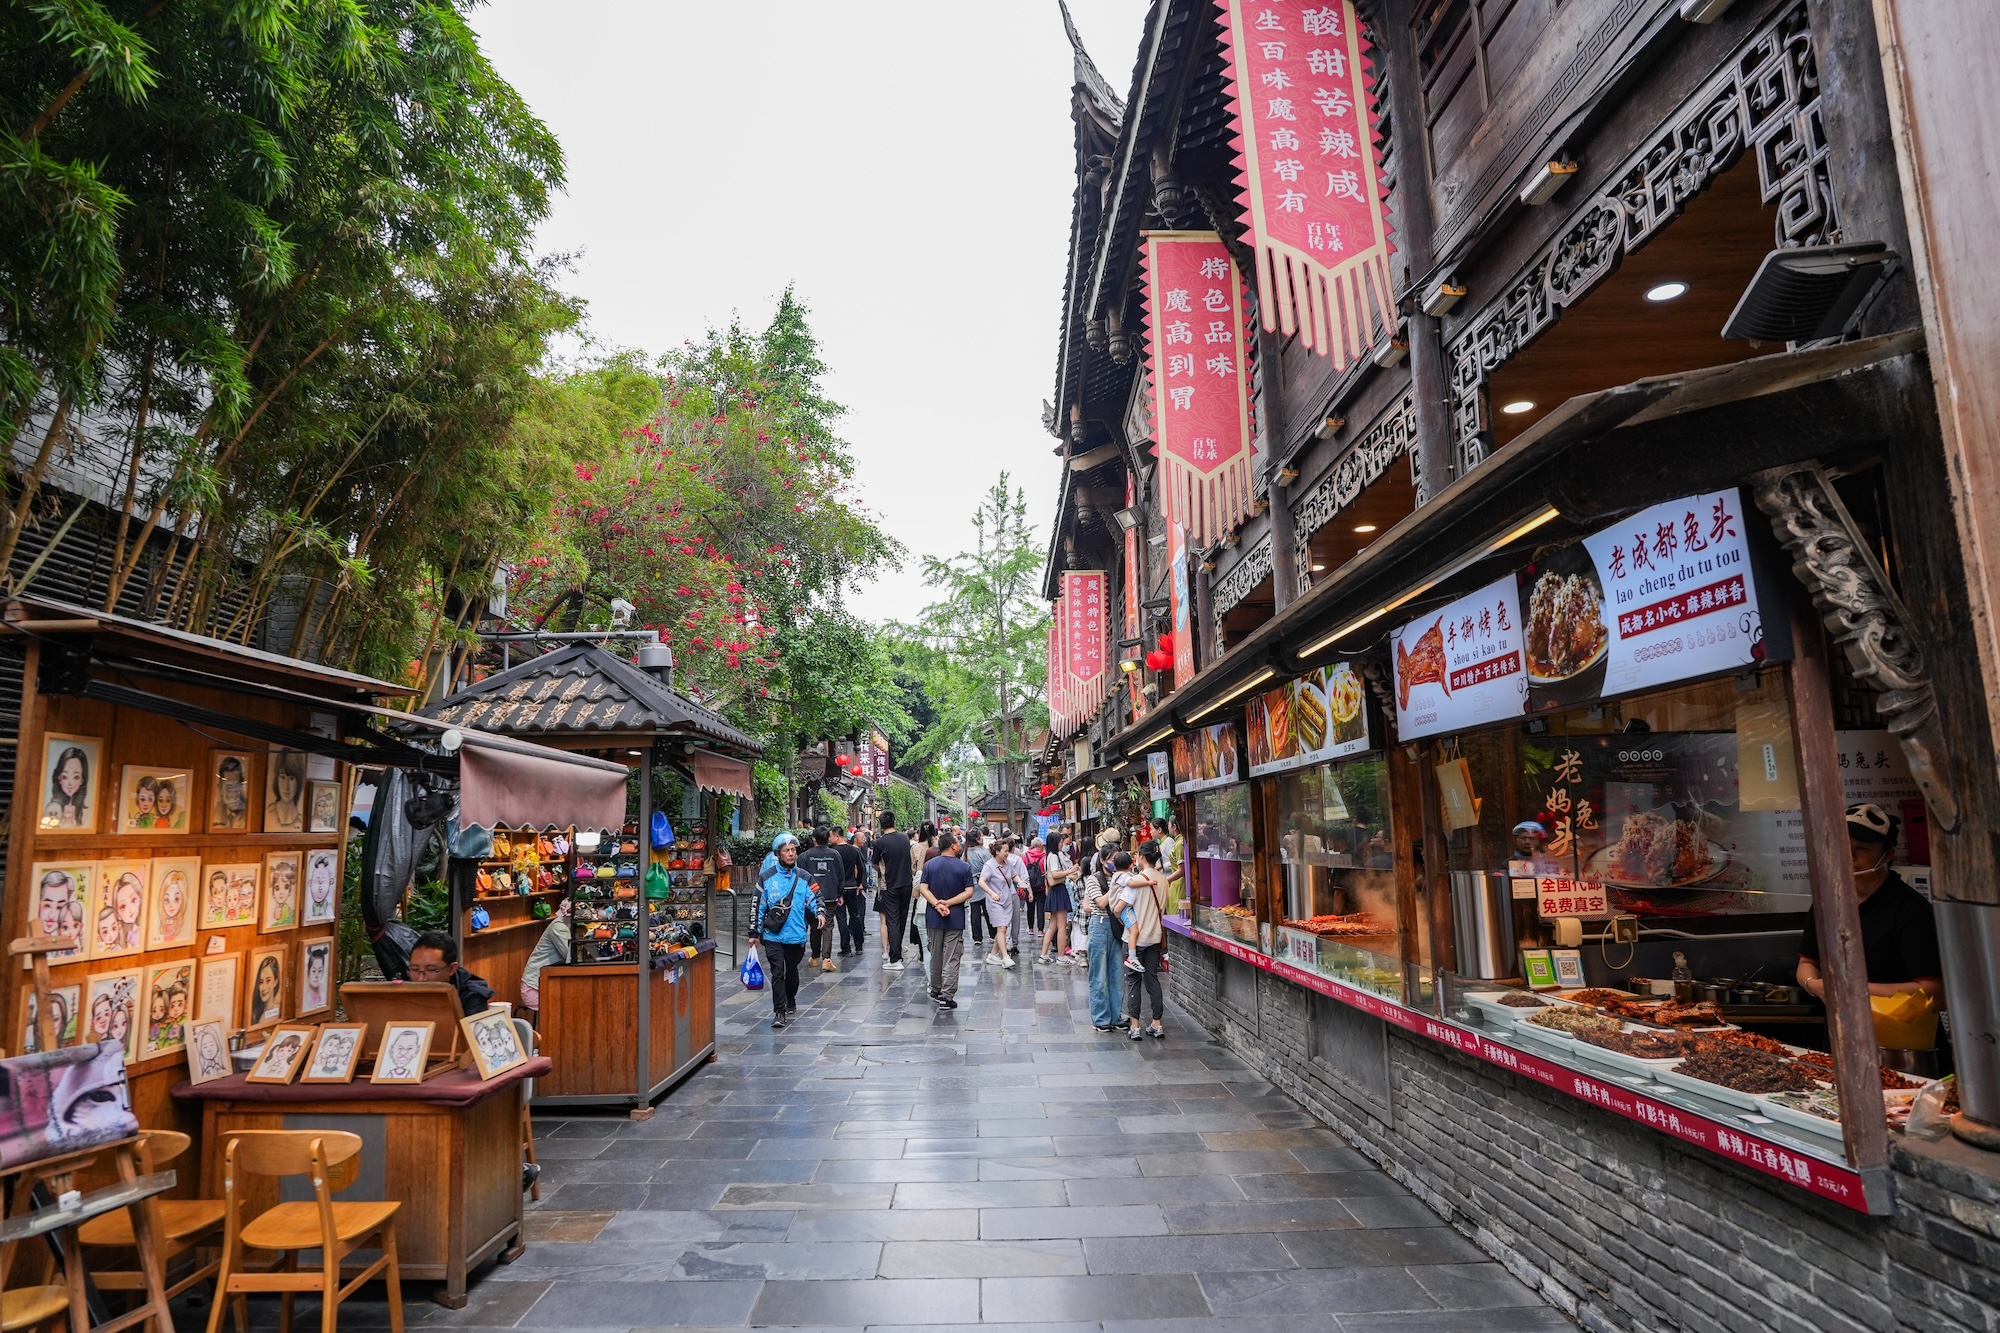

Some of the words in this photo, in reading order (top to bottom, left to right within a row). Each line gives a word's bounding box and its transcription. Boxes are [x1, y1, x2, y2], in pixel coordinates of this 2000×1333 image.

[1247, 0, 1308, 214] 生百味魔高皆有
[1302, 5, 1366, 203] 酸甜苦辣咸
[1199, 256, 1238, 377] 特色品味
[1163, 288, 1196, 411] 魔高到胃
[1608, 497, 1737, 583] 老成都兔头
[1615, 588, 1634, 605] lao
[1639, 571, 1676, 597] cheng
[1678, 563, 1696, 582] du
[1697, 558, 1713, 576] tu
[1716, 548, 1741, 569] tou
[1072, 577, 1083, 662] 带您体验美食之旅
[1086, 579, 1100, 660] 魔高特色小吃
[1446, 599, 1512, 652] 手撕烤兔
[1620, 581, 1745, 636] 成都名小吃·麻辣鲜香
[1453, 652, 1470, 667] shou
[1472, 647, 1480, 661] si
[1482, 643, 1496, 657] kao
[1498, 639, 1508, 651] tu
[1453, 658, 1517, 688] 四川特产·百年传承
[1543, 896, 1605, 914] 免费真空
[1483, 1043, 1518, 1069] 手撕烤兔肉
[1573, 1077, 1611, 1105] 香辣牛肉
[1635, 1099, 1681, 1134] 灯影牛肉
[1680, 1124, 1707, 1143] 148元/斤
[1716, 1129, 1812, 1184] 麻辣/五香兔腿
[1816, 1175, 1849, 1197] 25元/个
